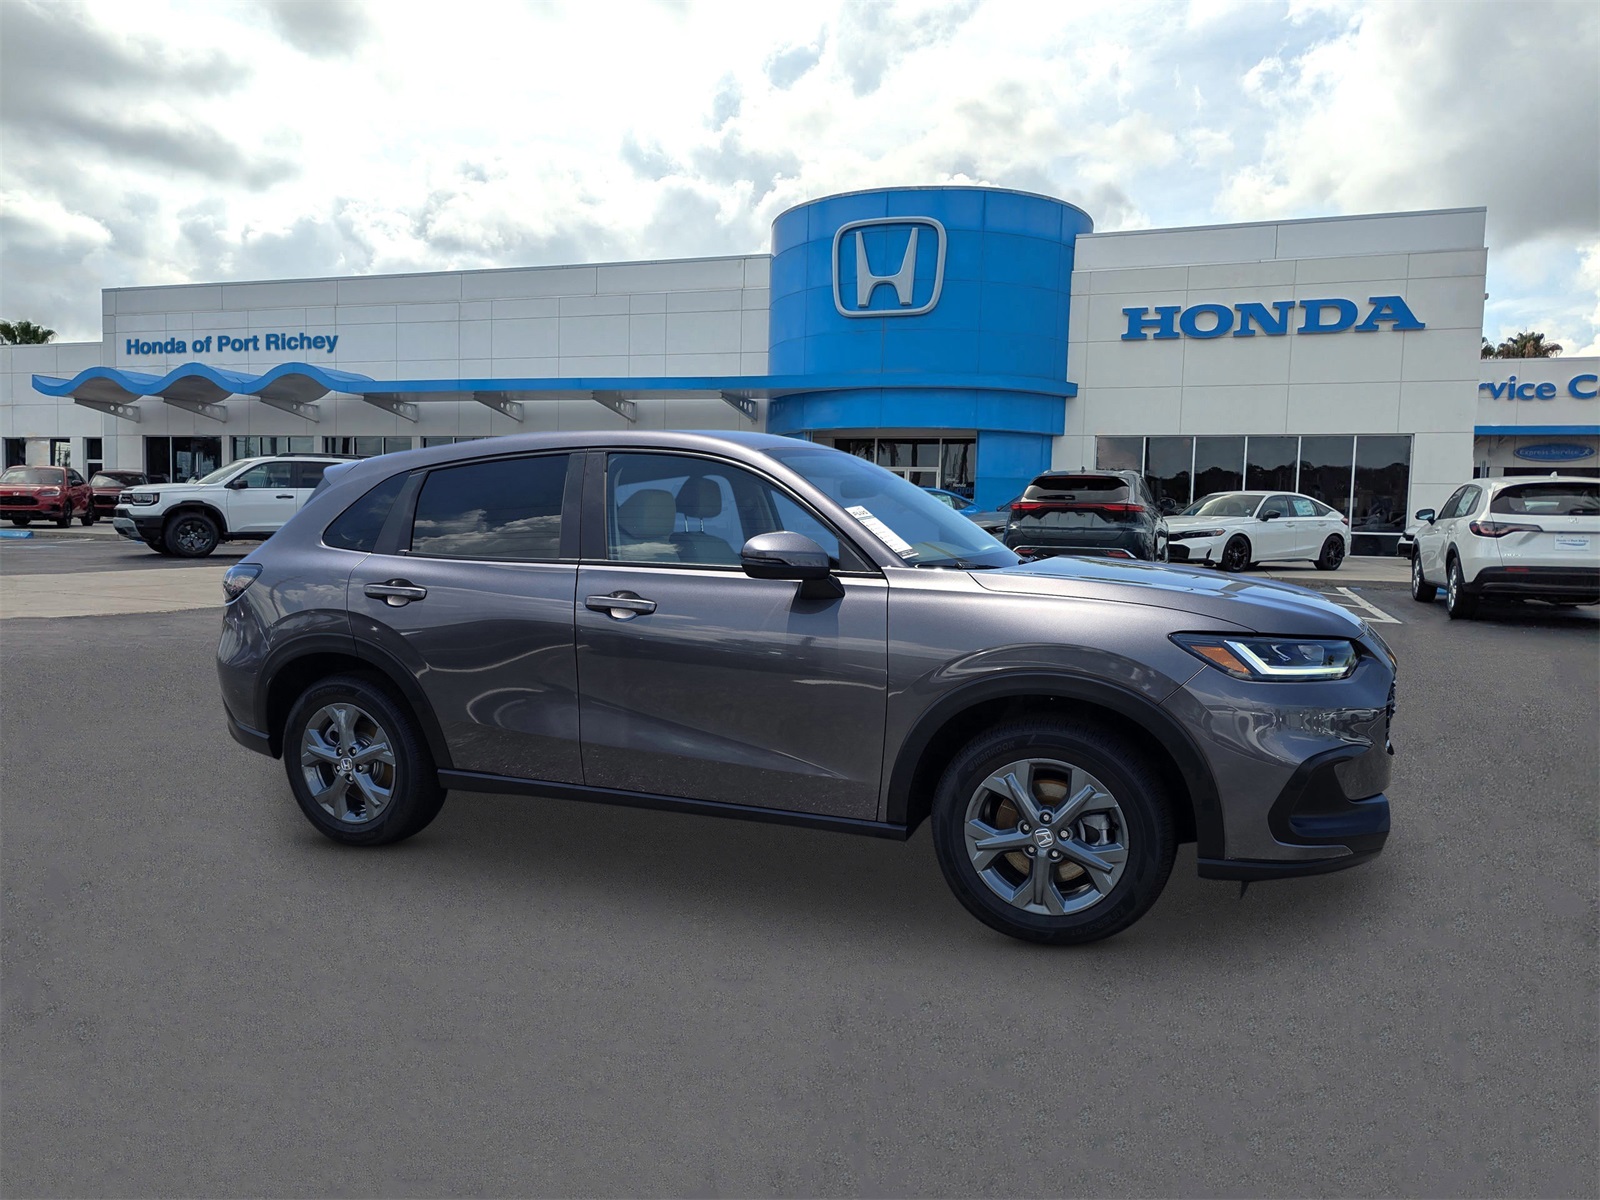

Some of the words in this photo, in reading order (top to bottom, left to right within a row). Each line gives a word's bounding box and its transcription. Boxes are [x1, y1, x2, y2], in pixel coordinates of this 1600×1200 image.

[1121, 295, 1426, 340] HONDA
[126, 337, 187, 355] Honda
[192, 335, 212, 353] of
[217, 335, 260, 352] Port
[265, 332, 339, 354] Richey
[1568, 373, 1600, 400] C
